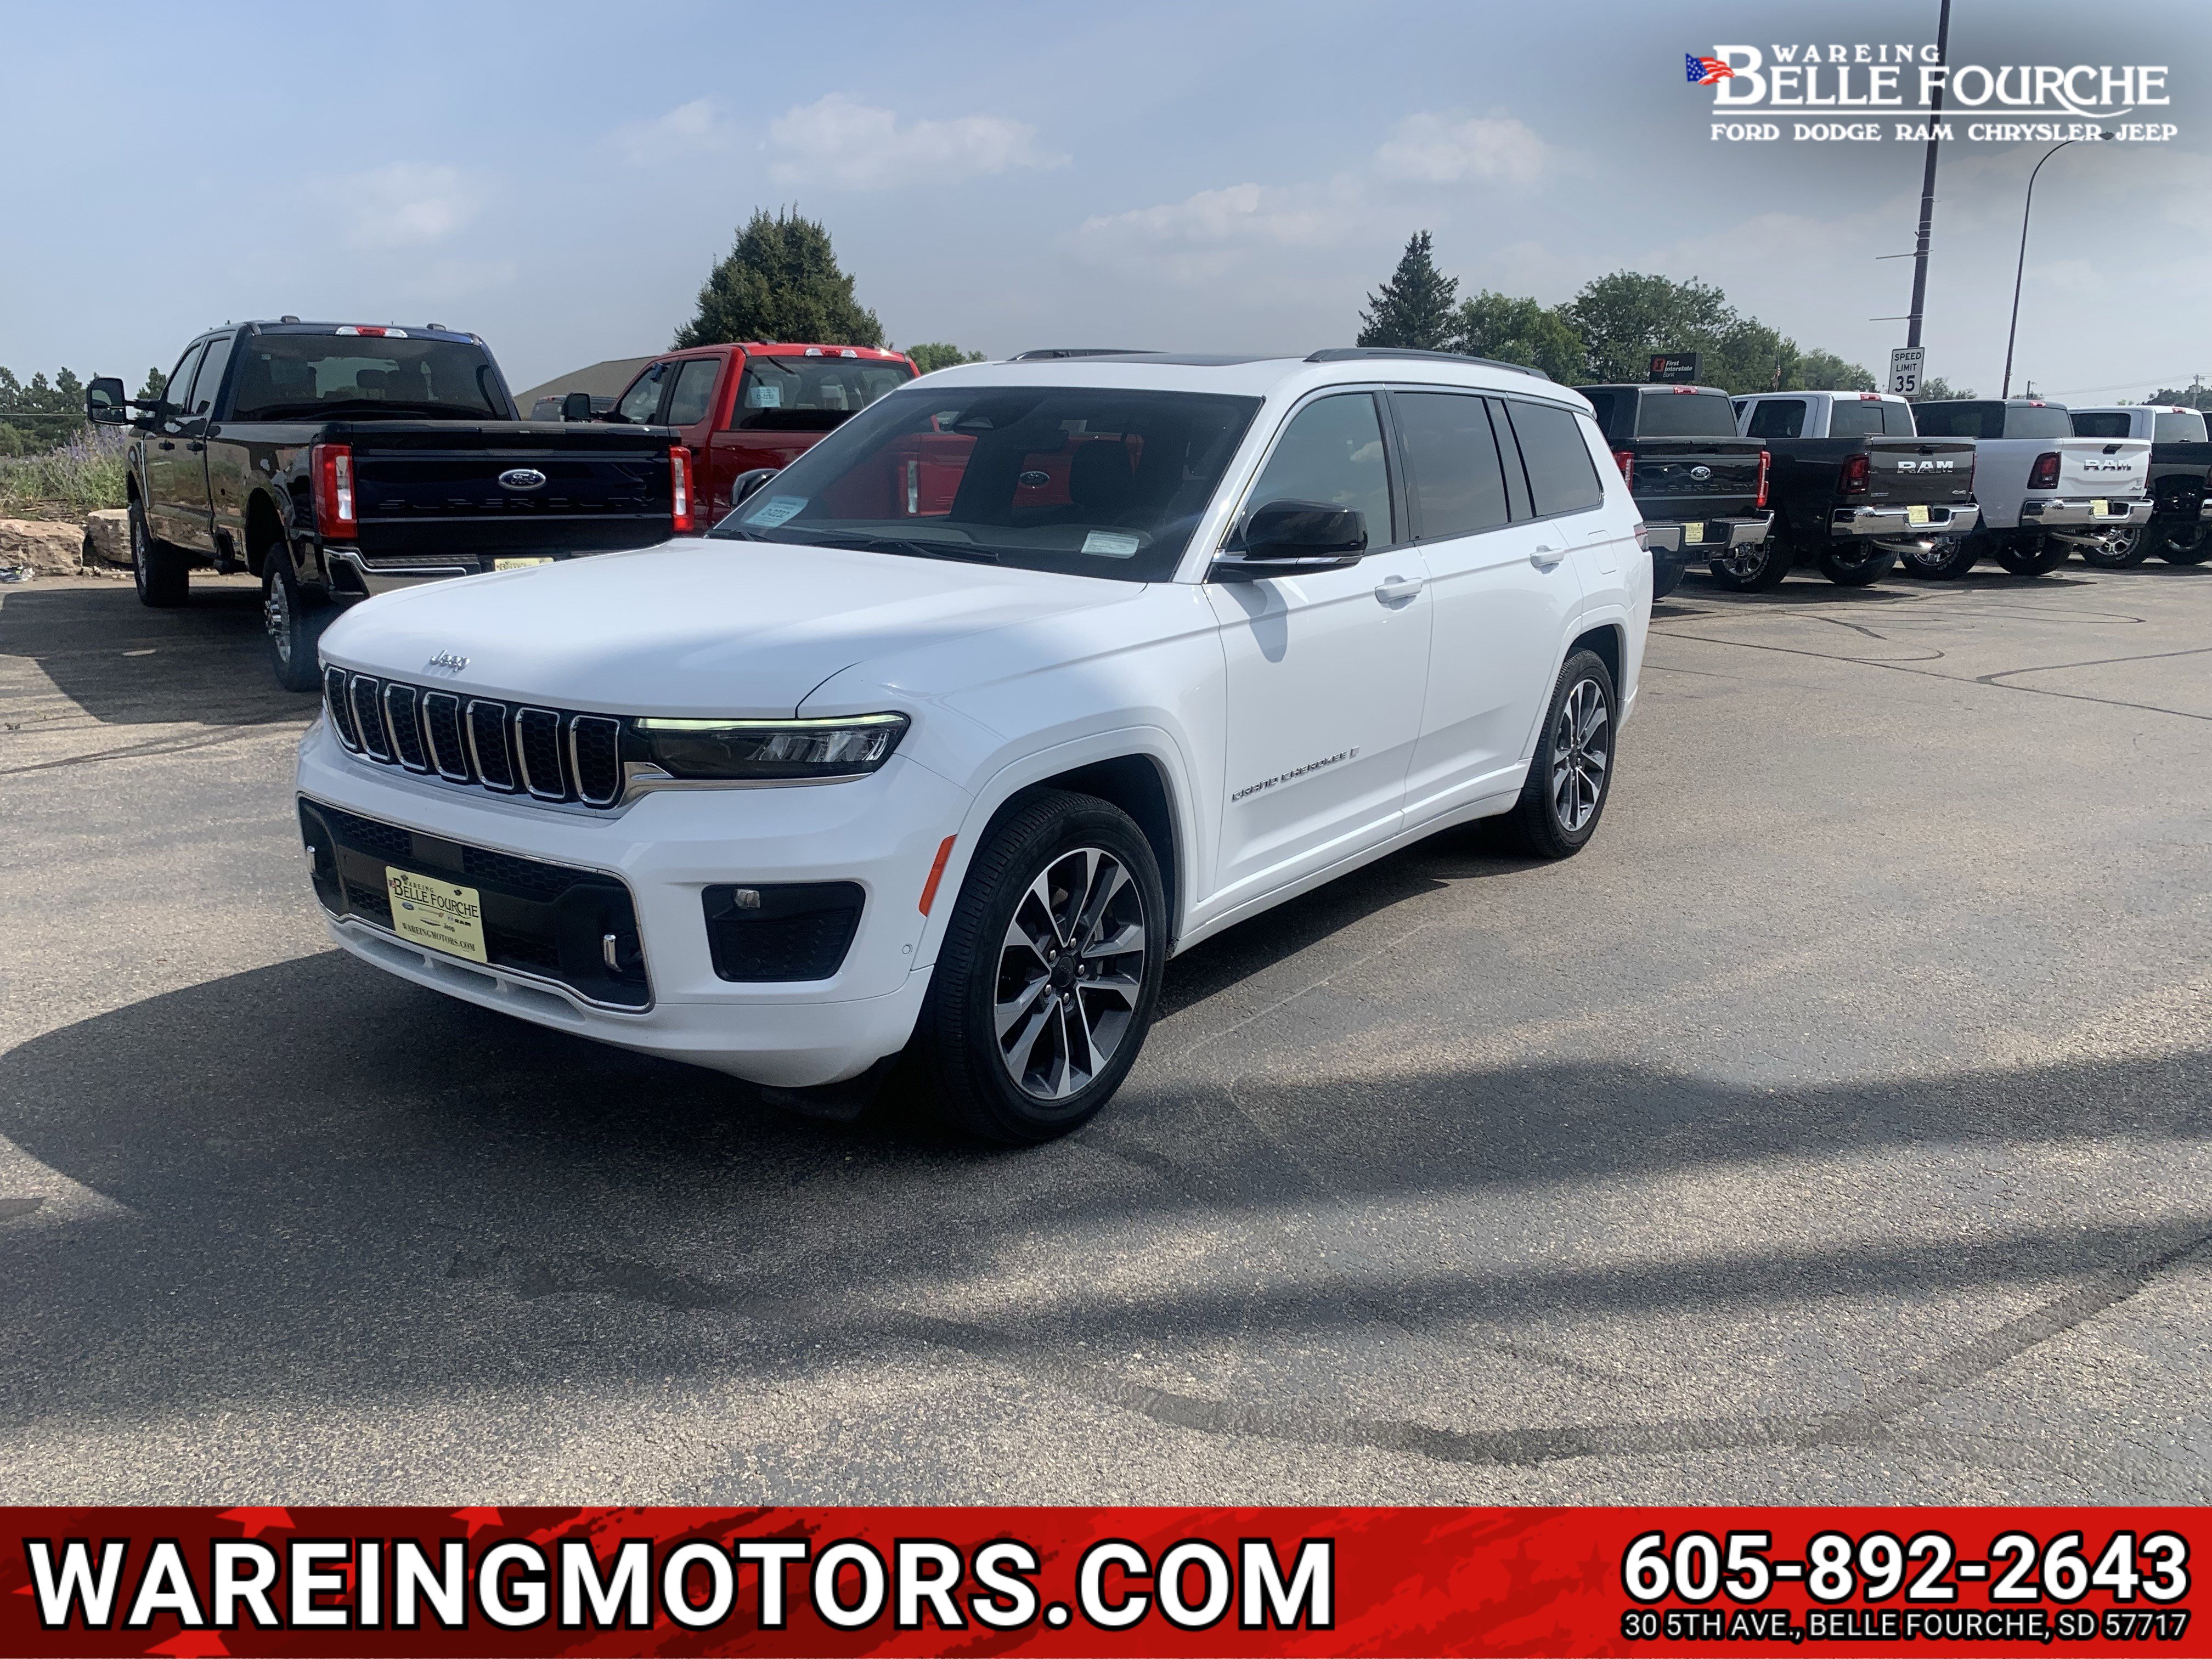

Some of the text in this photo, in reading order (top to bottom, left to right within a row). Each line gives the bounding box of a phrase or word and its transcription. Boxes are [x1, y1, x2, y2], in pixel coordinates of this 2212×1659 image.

[1894, 352, 1921, 361] SPEED
[1896, 363, 1917, 371] LIMIT
[1895, 375, 1915, 392] 35
[1897, 461, 1954, 473] RAM
[2084, 460, 2131, 471] RAM
[430, 650, 471, 673] Jeep
[1231, 776, 1279, 802] GRAND
[1280, 749, 1348, 783] CHEROKEE
[404, 879, 434, 894] WAREING
[393, 877, 479, 919] BELLE FOURCHE
[454, 918, 471, 927] RAM
[402, 922, 476, 952] WAREINGMOTORS.COM
